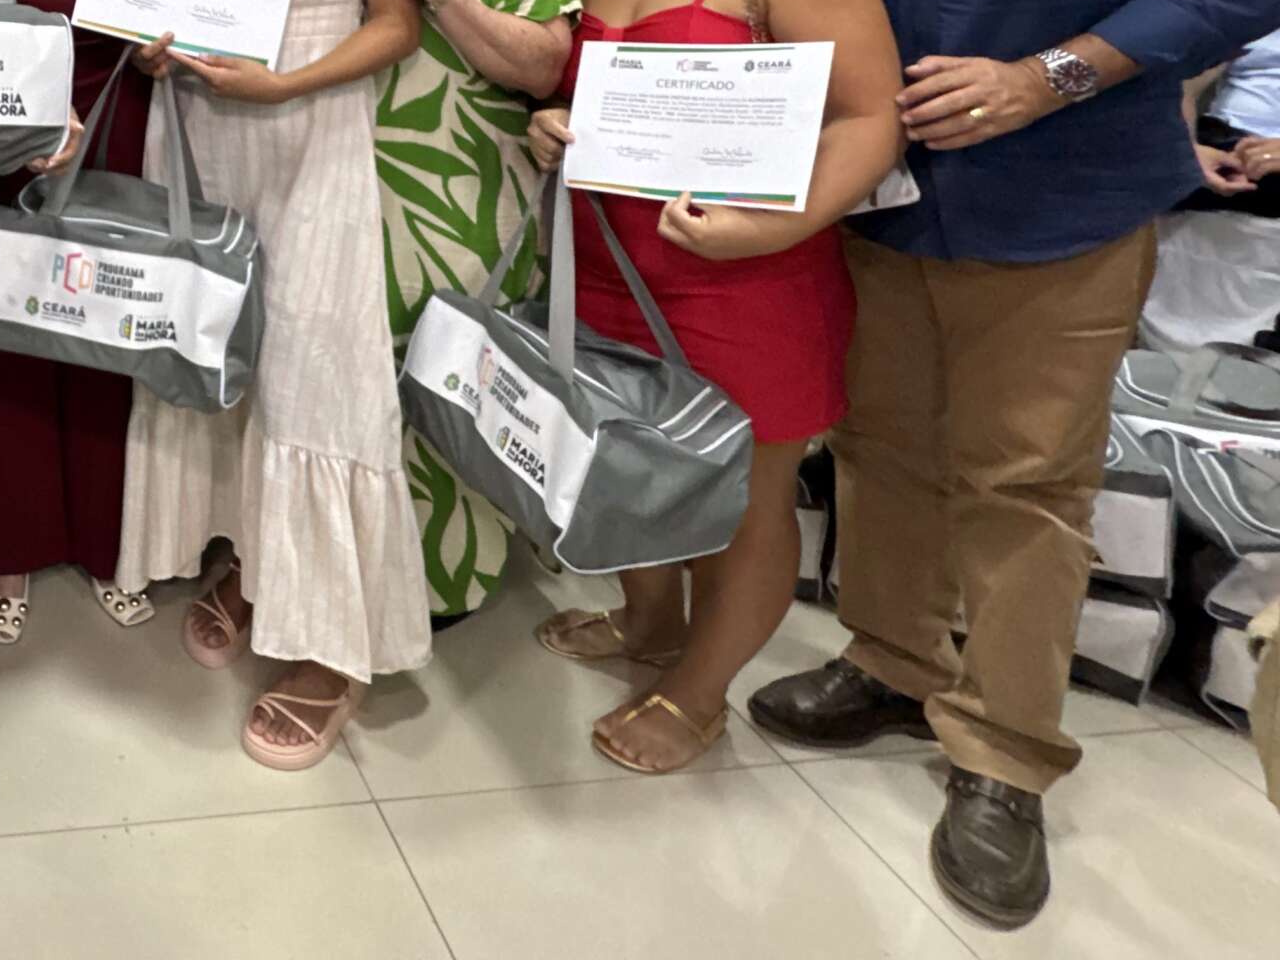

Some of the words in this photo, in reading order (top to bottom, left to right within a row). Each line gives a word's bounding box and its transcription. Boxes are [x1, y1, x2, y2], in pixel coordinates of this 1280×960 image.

[757, 58, 792, 68] CEARÁ
[656, 78, 735, 90] CERTIFICADO
[97, 261, 145, 279] PROGRAMA
[96, 273, 133, 288] CRIANDO
[94, 286, 164, 303] OPORTUNIDADES
[42, 301, 87, 319] CEARÁ
[136, 320, 176, 330] MARIA
[145, 329, 178, 342] HORA
[510, 437, 545, 474] MARIA
[513, 453, 544, 489] HORA
